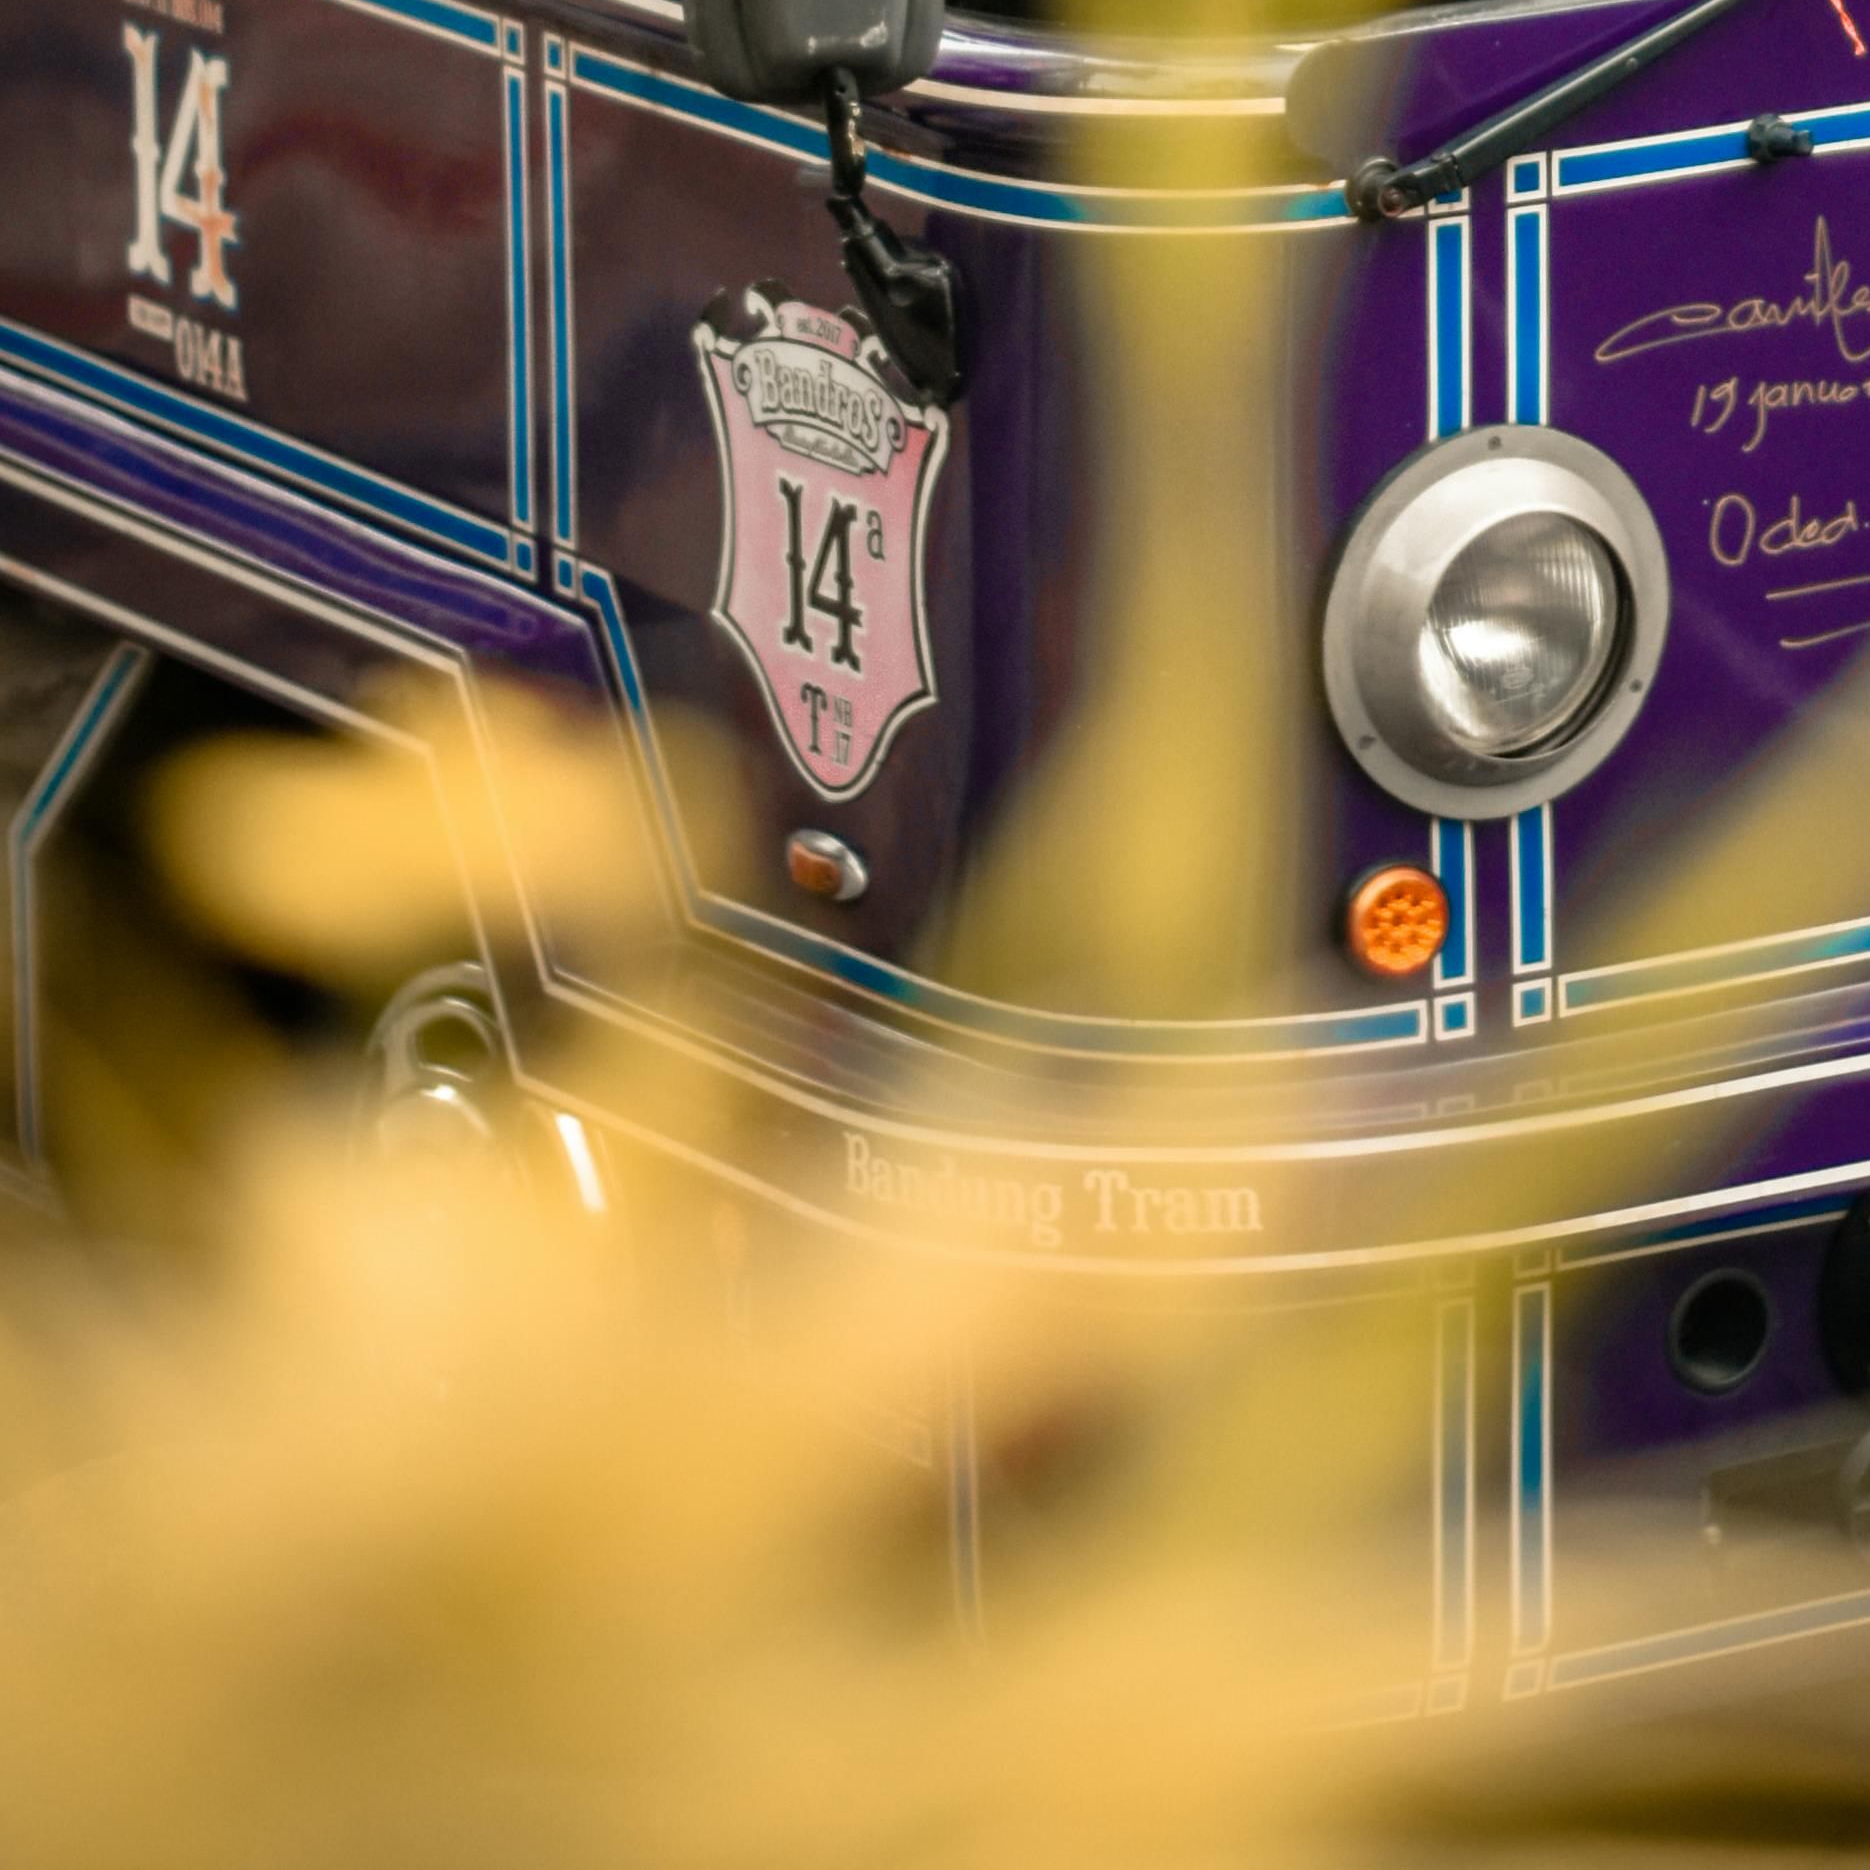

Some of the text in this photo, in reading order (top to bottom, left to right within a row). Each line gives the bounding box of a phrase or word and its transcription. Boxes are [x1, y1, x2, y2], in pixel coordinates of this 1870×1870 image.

[123, 22, 240, 309] 14
[753, 347, 884, 453] Bandros
[1690, 376, 1739, 434] 19
[800, 681, 828, 755] T
[1083, 1168, 1264, 1235] Tram
